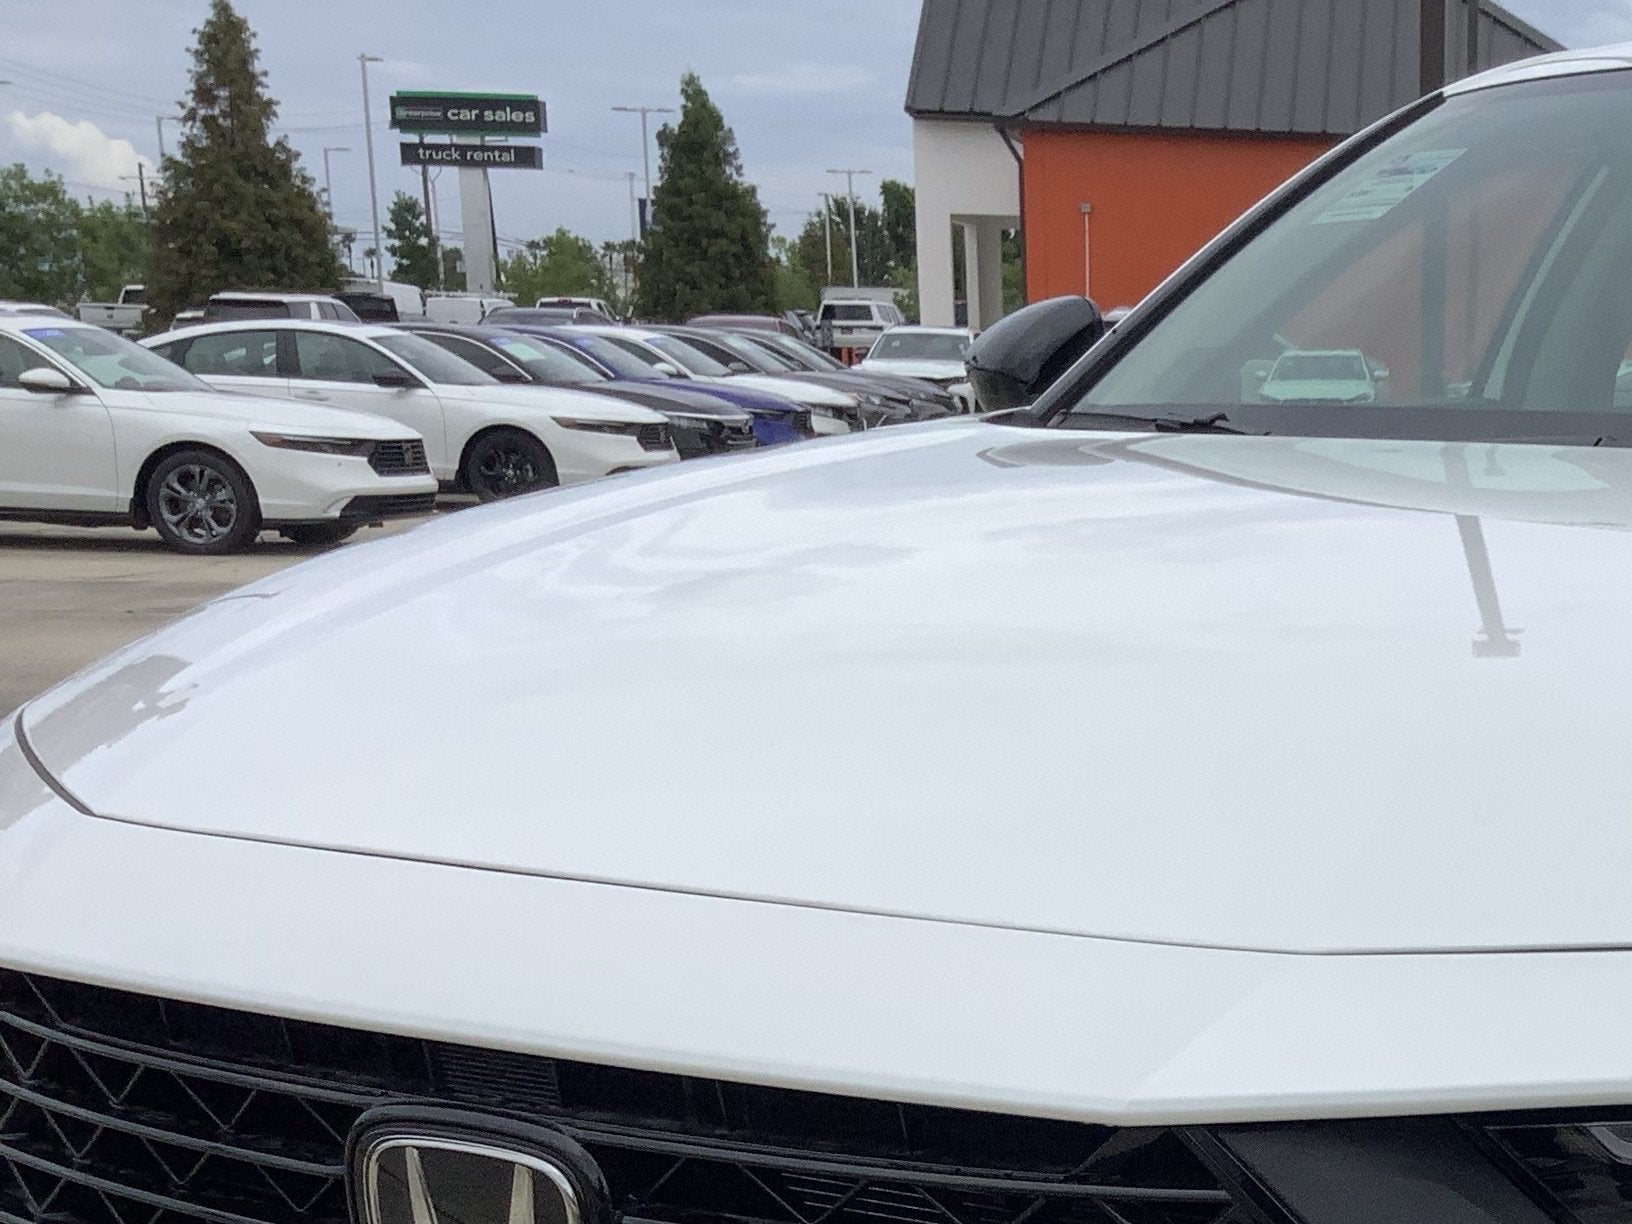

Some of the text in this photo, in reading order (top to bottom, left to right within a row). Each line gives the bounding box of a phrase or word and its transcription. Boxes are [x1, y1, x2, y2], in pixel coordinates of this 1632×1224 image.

[447, 108, 480, 121] car
[483, 106, 535, 123] sales
[417, 147, 515, 162] truck rental
